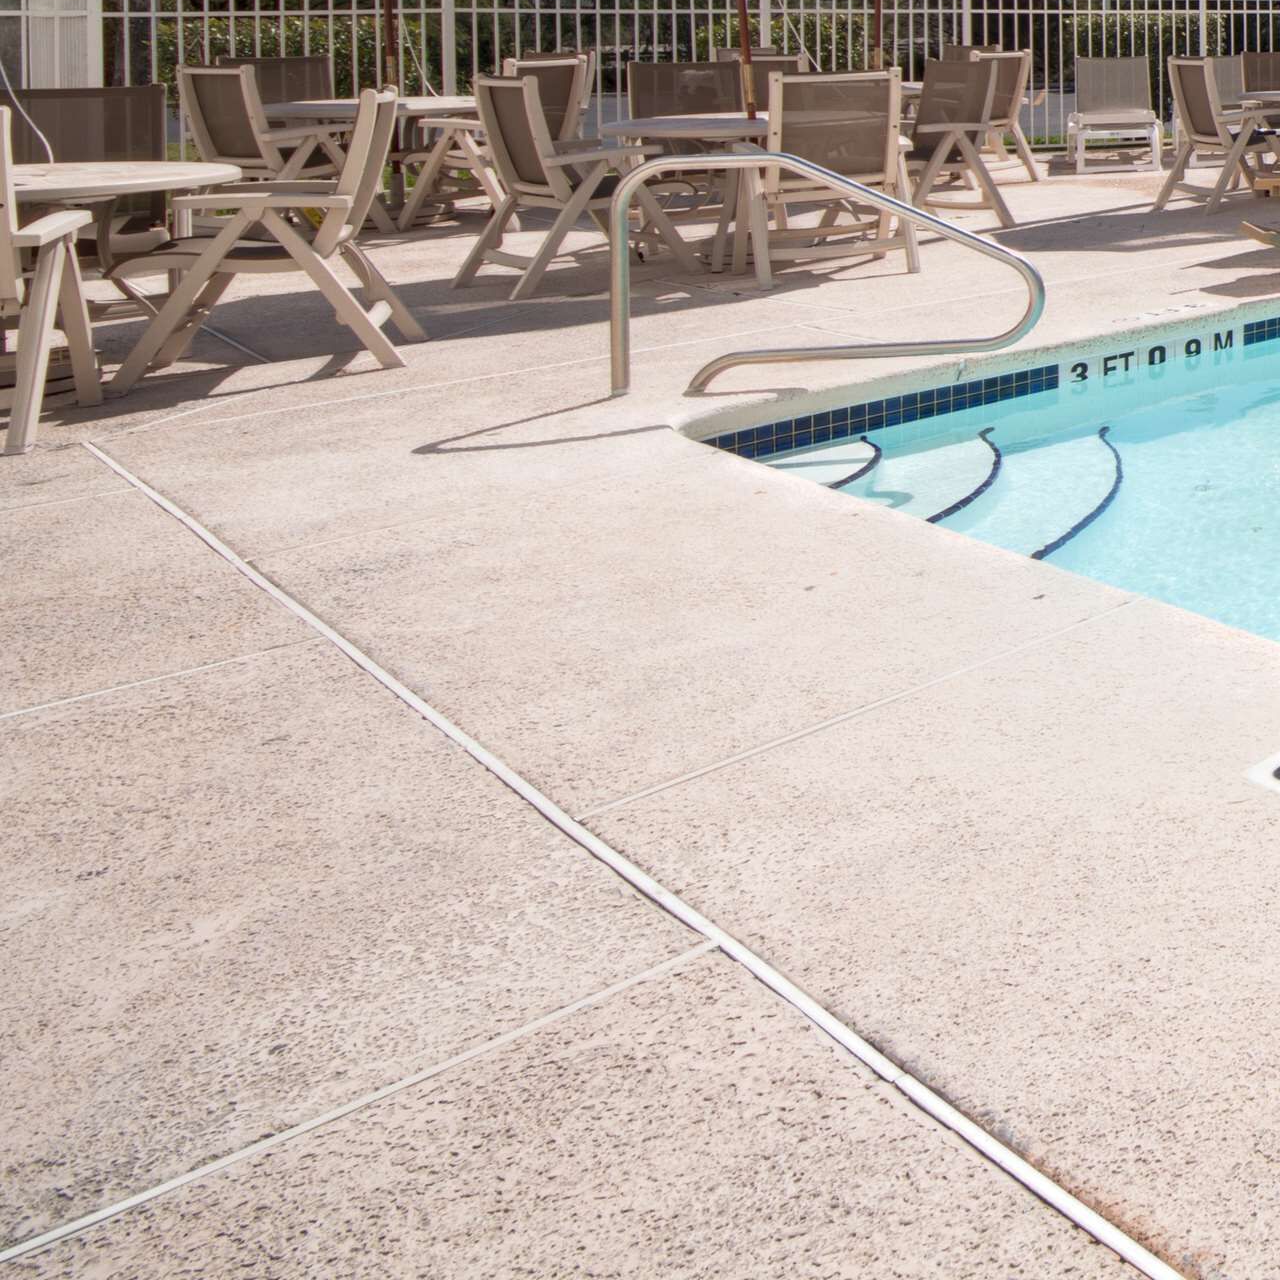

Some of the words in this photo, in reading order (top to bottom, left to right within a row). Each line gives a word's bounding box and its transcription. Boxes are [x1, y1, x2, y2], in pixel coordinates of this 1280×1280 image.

[1070, 362, 1088, 383] 3
[1103, 351, 1134, 376] FT
[1214, 330, 1233, 351] M
